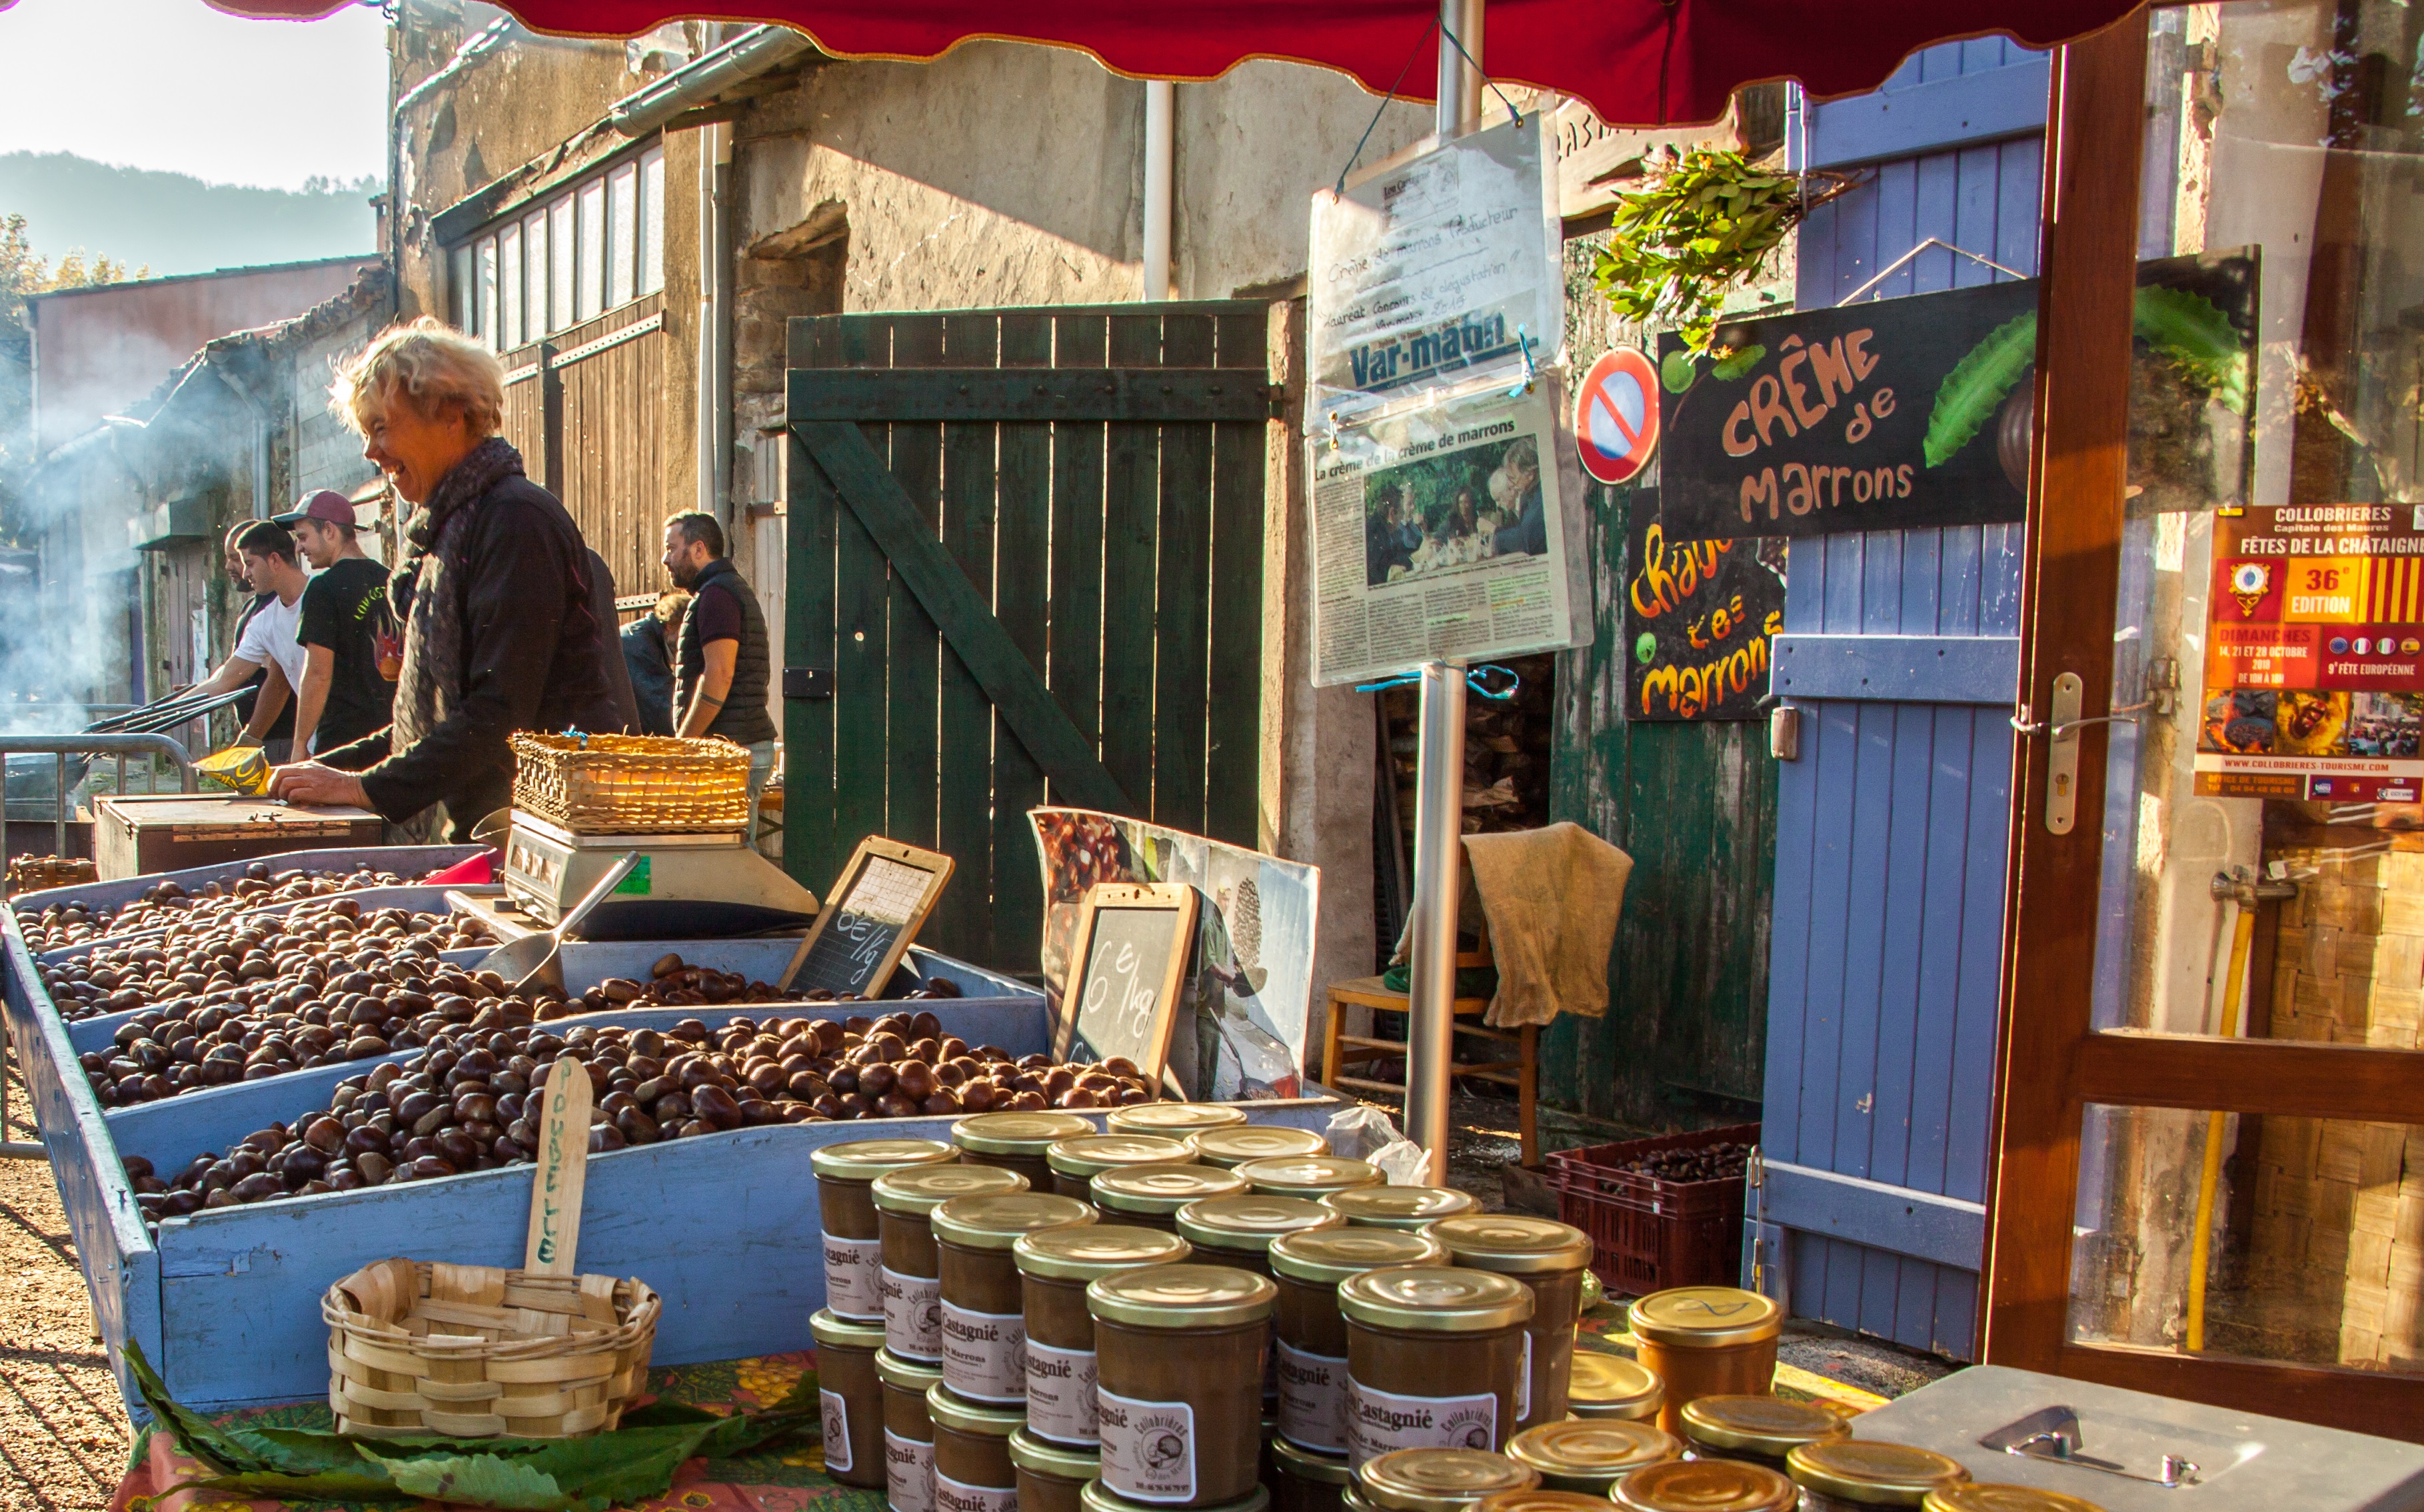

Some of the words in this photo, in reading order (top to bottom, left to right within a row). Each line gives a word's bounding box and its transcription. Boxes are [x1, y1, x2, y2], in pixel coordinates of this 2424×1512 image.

[1722, 328, 1880, 457] CRÊME
[1845, 388, 1896, 444] de
[1314, 468, 1326, 481] La
[1329, 460, 1364, 477] crème
[1366, 451, 1381, 466] de
[1384, 448, 1395, 462] la
[1398, 440, 1435, 462] crème
[1438, 430, 1454, 448] de
[1458, 419, 1515, 442] marrons
[2275, 506, 2392, 523] COLLOBRIERES
[2274, 524, 2321, 534] Capitale
[2323, 524, 2343, 532] des
[2346, 523, 2389, 532] Maures
[2241, 534, 2287, 554] FÊTES
[2290, 538, 2310, 554] DE
[2313, 538, 2334, 554] LA
[2291, 596, 2351, 614] EDITION
[2219, 629, 2311, 644] DIMANCHES
[2232, 646, 2242, 657] 21
[2243, 646, 2254, 657] ET
[2269, 646, 2308, 658] OCTOBRE
[2338, 661, 2357, 675] FÊTE
[2360, 661, 2415, 676] EUROPÉENNE
[2238, 673, 2248, 684] DE
[942, 1312, 999, 1343] Castagnié
